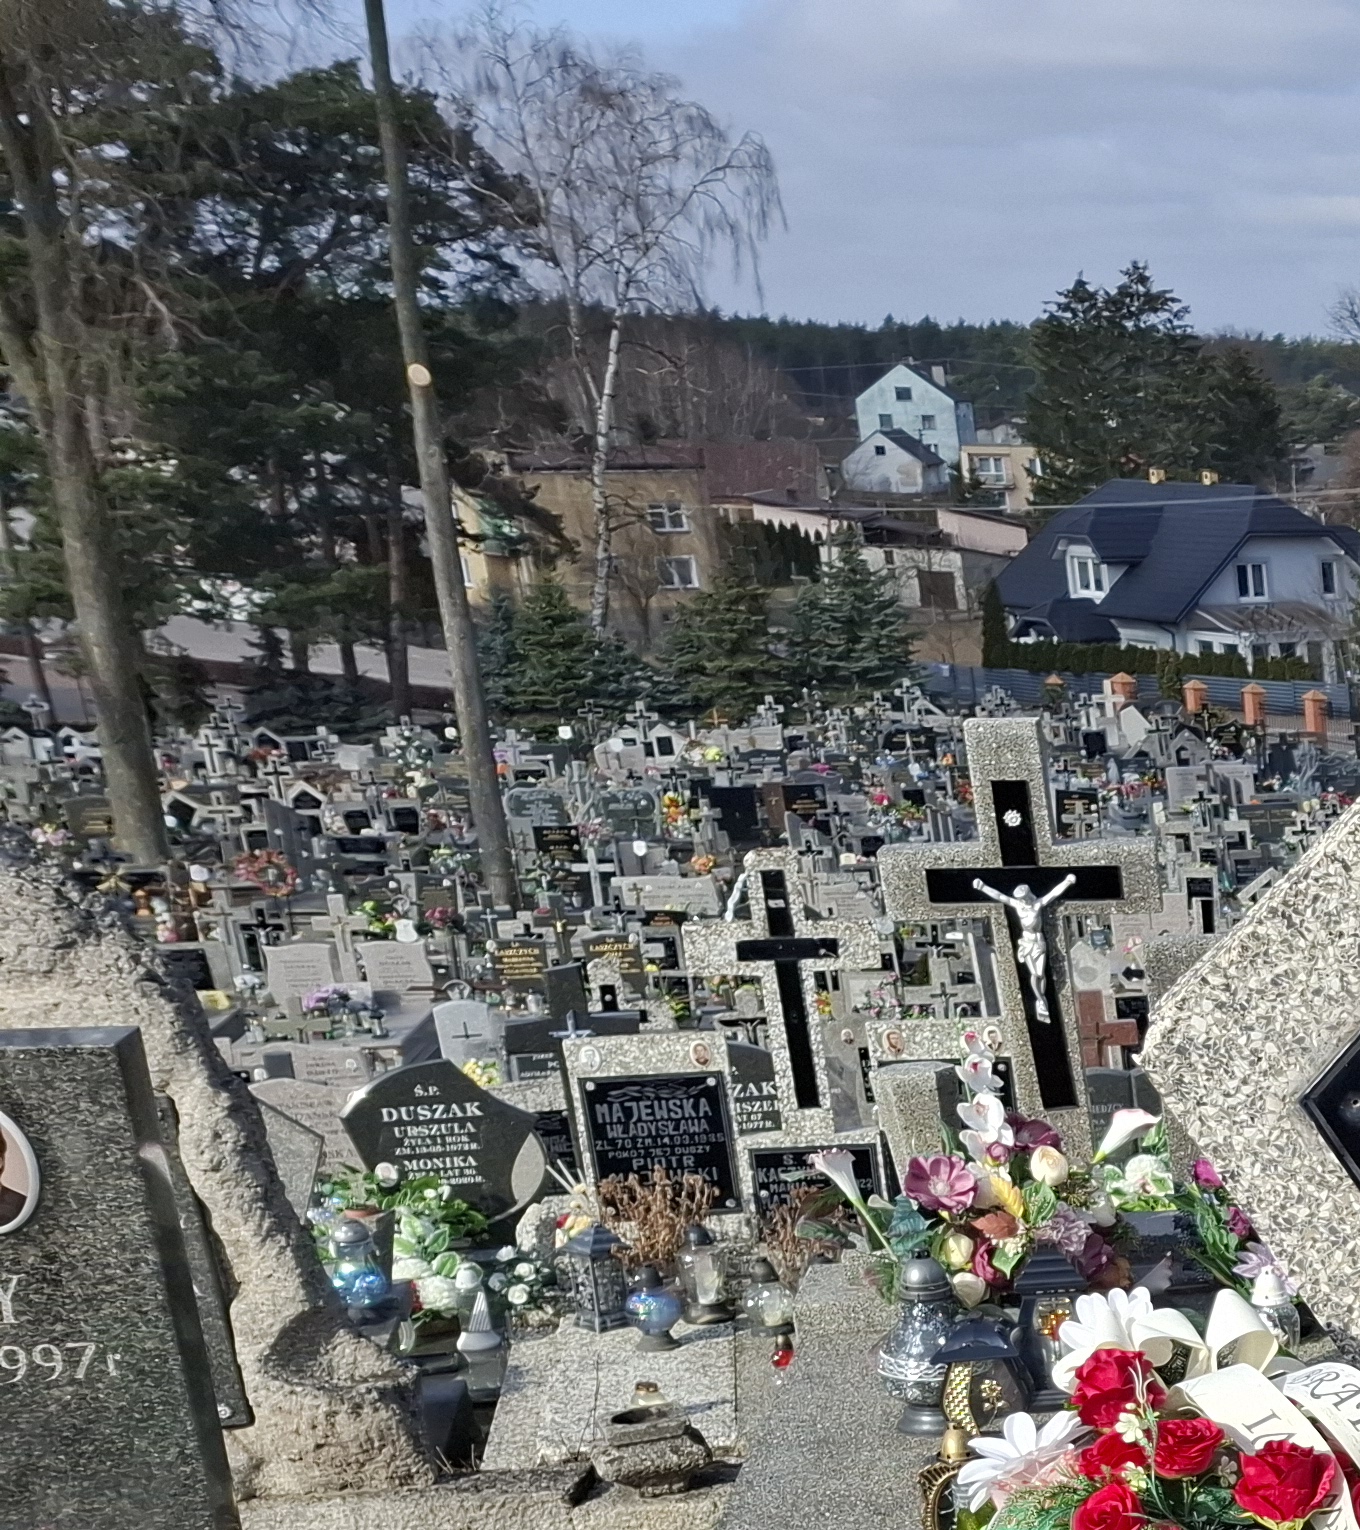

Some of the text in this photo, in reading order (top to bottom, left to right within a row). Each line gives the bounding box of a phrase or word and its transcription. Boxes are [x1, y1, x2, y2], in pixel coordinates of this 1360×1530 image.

[733, 1080, 777, 1098] ZAK
[381, 1102, 484, 1122] DUSZAK
[595, 1098, 712, 1124] MAJEWSKA
[394, 1122, 477, 1139] URSZULA
[606, 1118, 710, 1139] WŁADYSŁAWA
[403, 1156, 478, 1171] MONIKA
[632, 1156, 696, 1170] PIOTR
